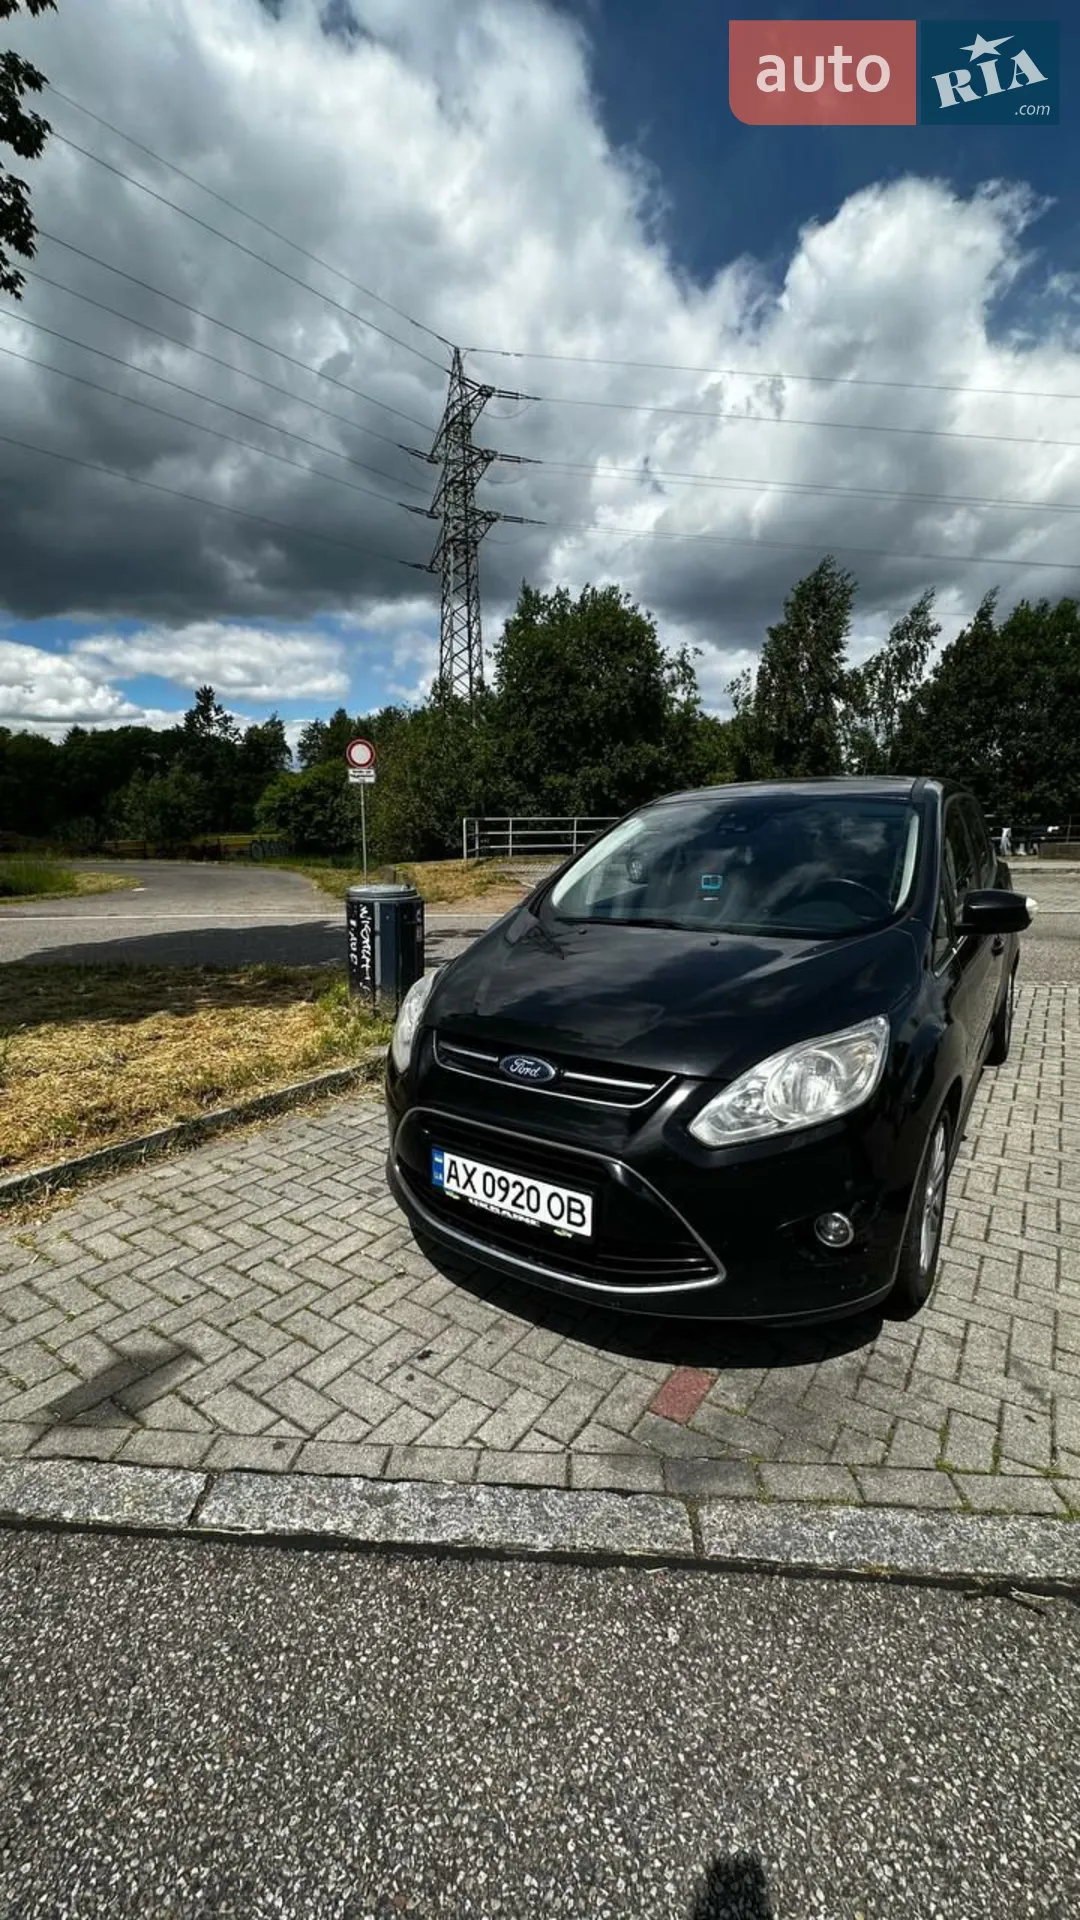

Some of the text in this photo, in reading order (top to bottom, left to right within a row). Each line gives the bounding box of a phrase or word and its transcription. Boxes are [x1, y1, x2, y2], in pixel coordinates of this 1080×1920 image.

[510, 1058, 541, 1078] Ford
[446, 1158, 586, 1228] AX 0920 OB
